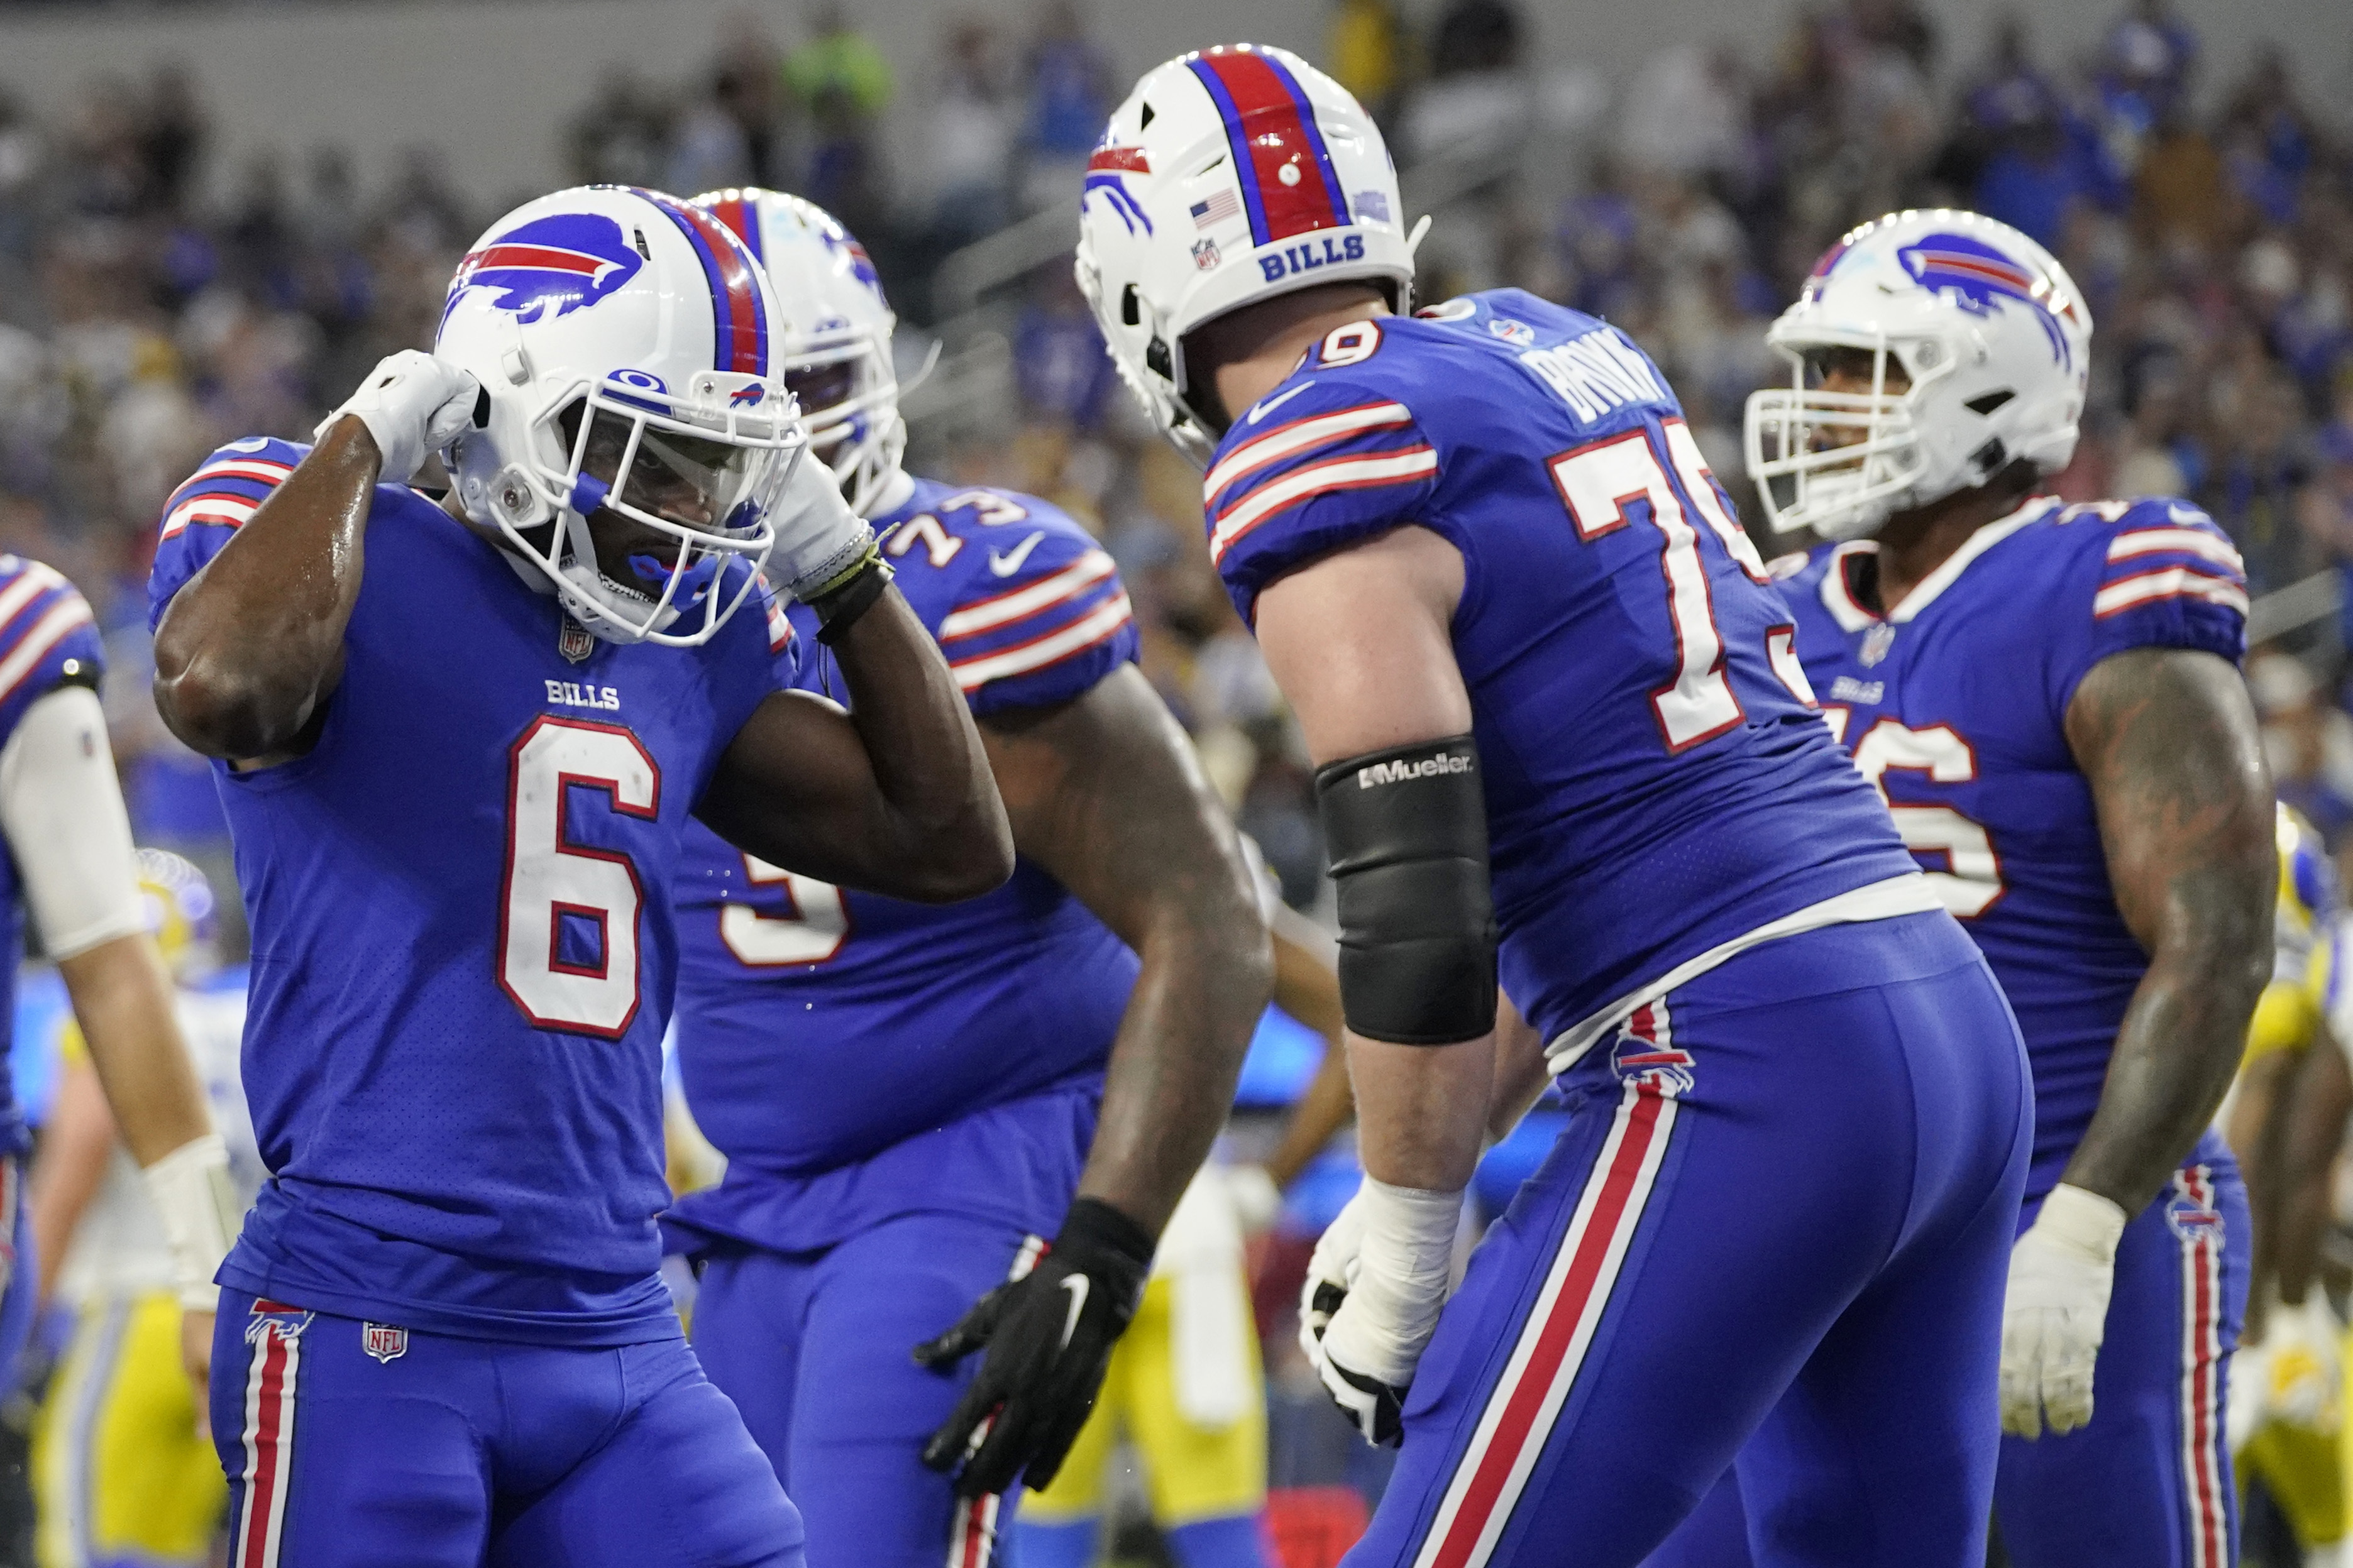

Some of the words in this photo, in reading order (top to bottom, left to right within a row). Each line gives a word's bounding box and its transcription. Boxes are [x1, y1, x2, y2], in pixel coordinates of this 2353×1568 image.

[1259, 234, 1365, 282] BILLS
[1311, 318, 1383, 372] 9
[884, 490, 1027, 568] 73
[566, 632, 588, 653] NFL
[544, 679, 620, 711] BILLS
[1374, 752, 1471, 784] Mueller
[1823, 703, 2007, 919] 6
[495, 712, 662, 1042] 6
[370, 1330, 400, 1352] NFL
